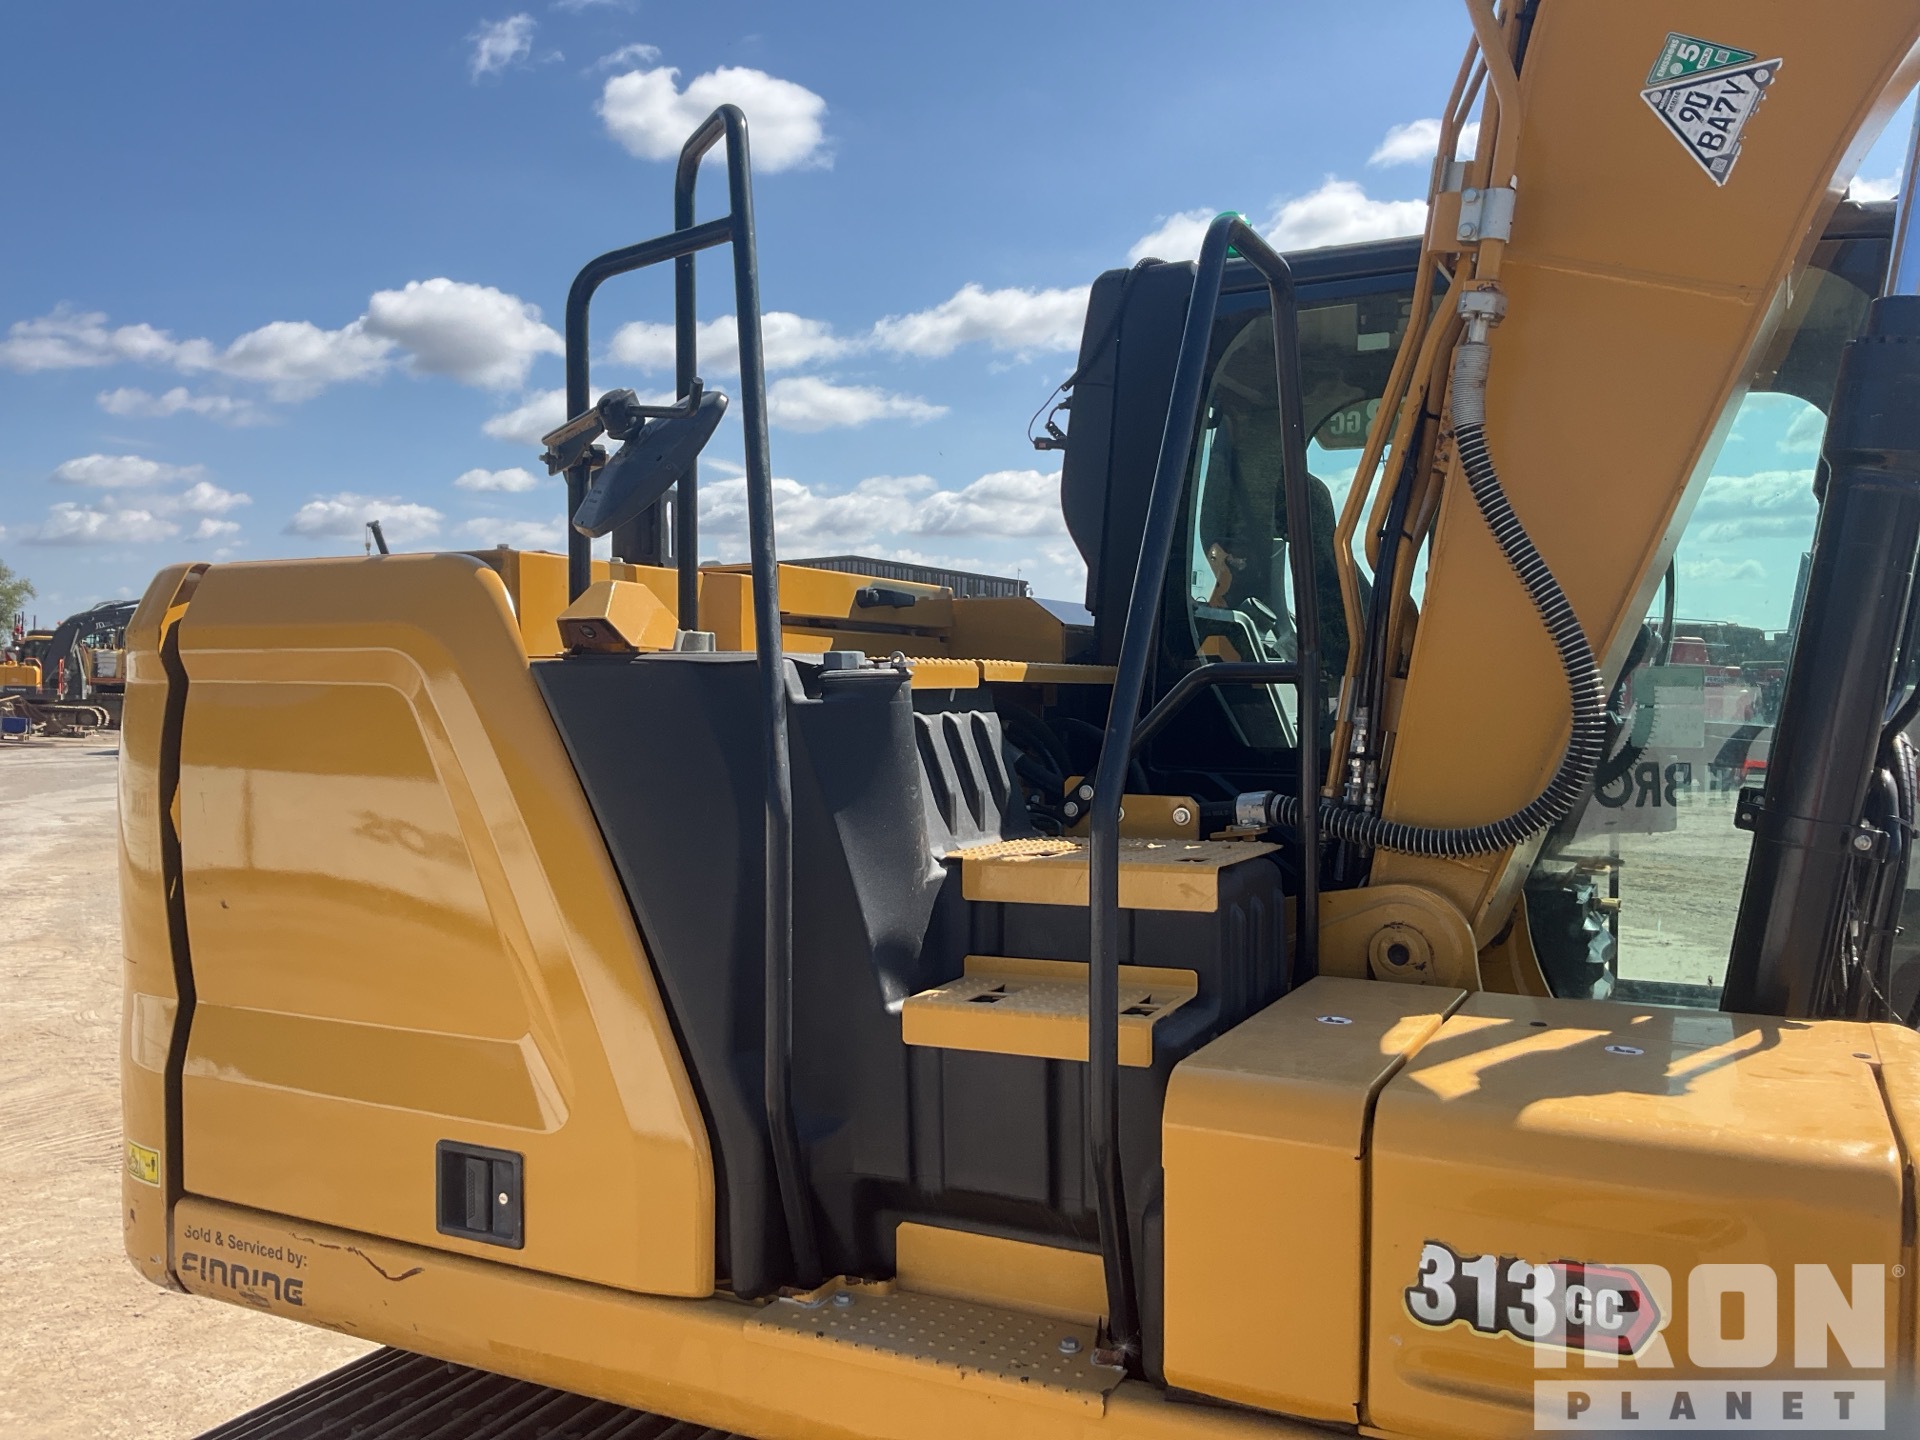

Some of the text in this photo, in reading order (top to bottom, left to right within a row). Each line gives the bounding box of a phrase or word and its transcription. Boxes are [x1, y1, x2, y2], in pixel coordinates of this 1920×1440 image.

[1657, 39, 1680, 77] EMISSIONS
[1676, 43, 1701, 62] 5
[1697, 79, 1749, 152] BA7Y
[184, 1225, 308, 1269] Sold & Serviced by:
[1408, 1243, 1624, 1338] 313 GC
